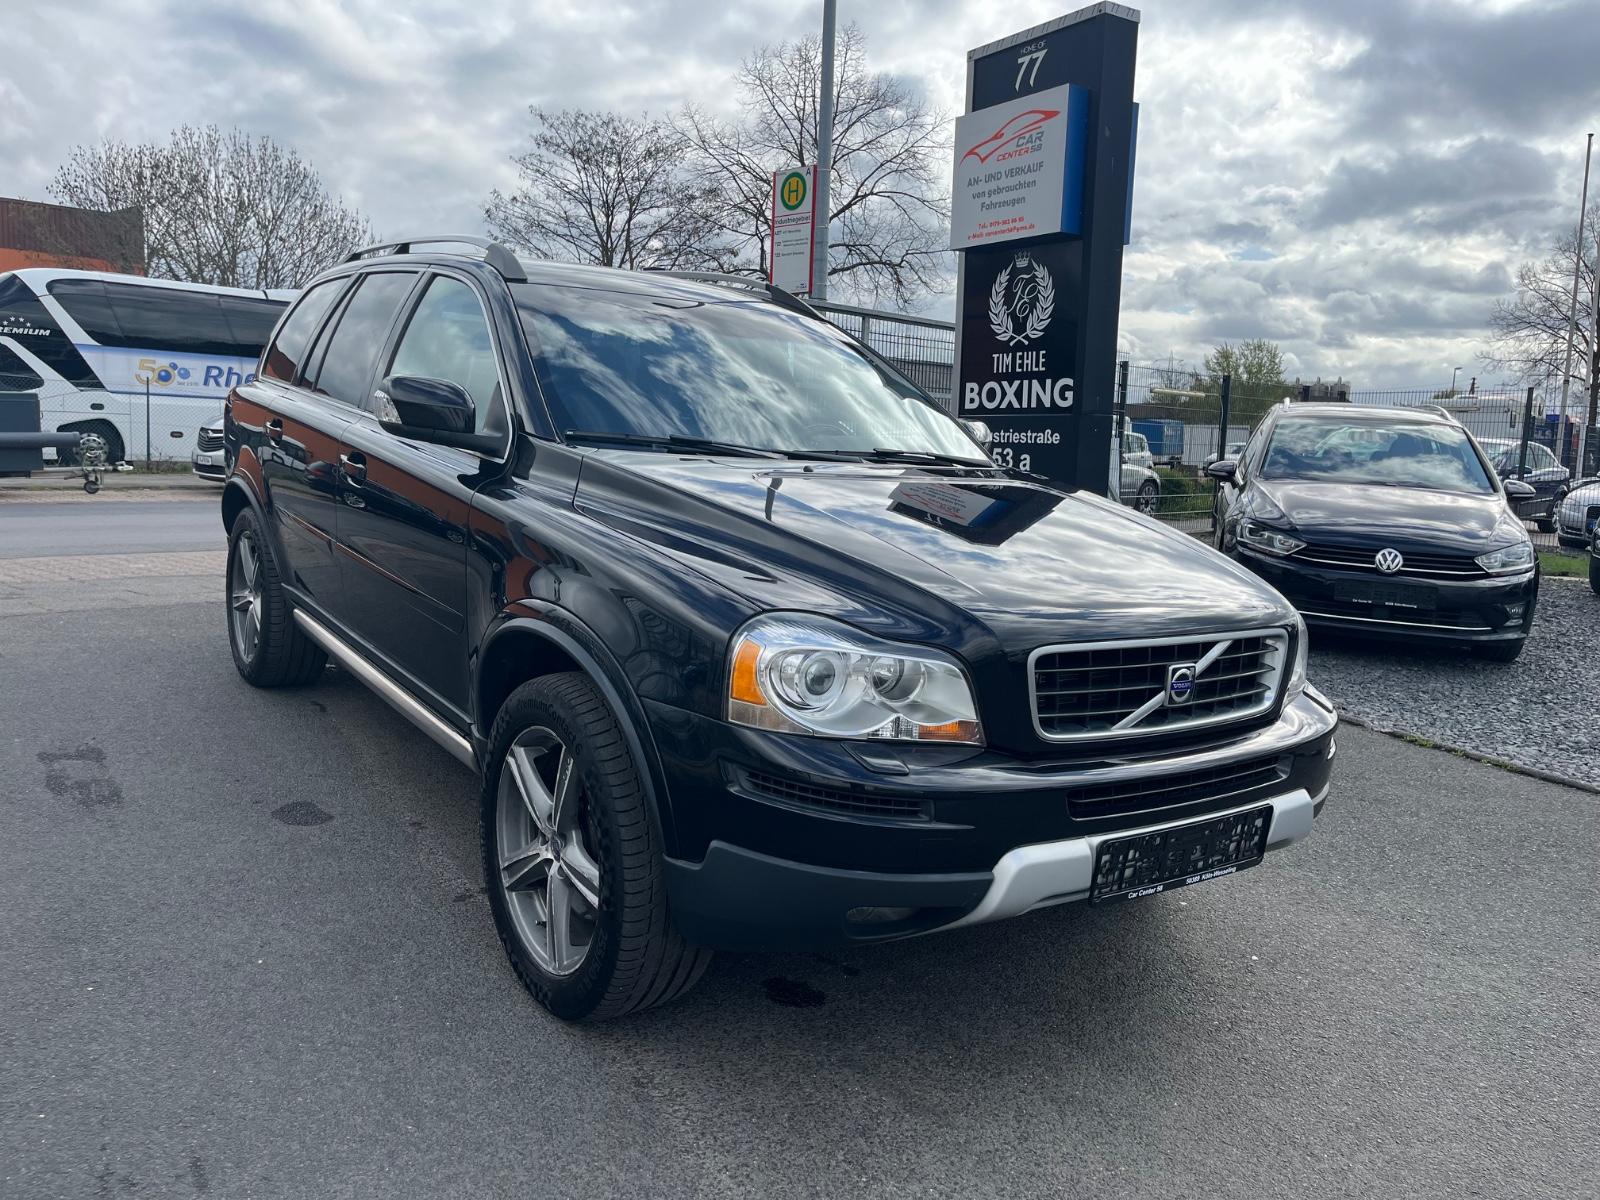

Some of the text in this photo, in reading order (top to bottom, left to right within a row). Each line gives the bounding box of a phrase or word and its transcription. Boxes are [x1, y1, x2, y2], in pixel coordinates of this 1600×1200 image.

[1015, 49, 1048, 92] 77
[1016, 131, 1044, 148] CAR
[805, 167, 812, 177] A
[984, 171, 1002, 183] UND
[1004, 161, 1044, 179] VERKAUF
[972, 179, 1037, 200] von gebrauchten
[980, 196, 1026, 212] Fahrzeugen
[992, 350, 1046, 374] TIM EHLE
[964, 377, 1074, 410] BOXING
[991, 428, 1060, 444] striestraße
[992, 447, 1031, 471] 53 a
[1138, 887, 1156, 896] Center
